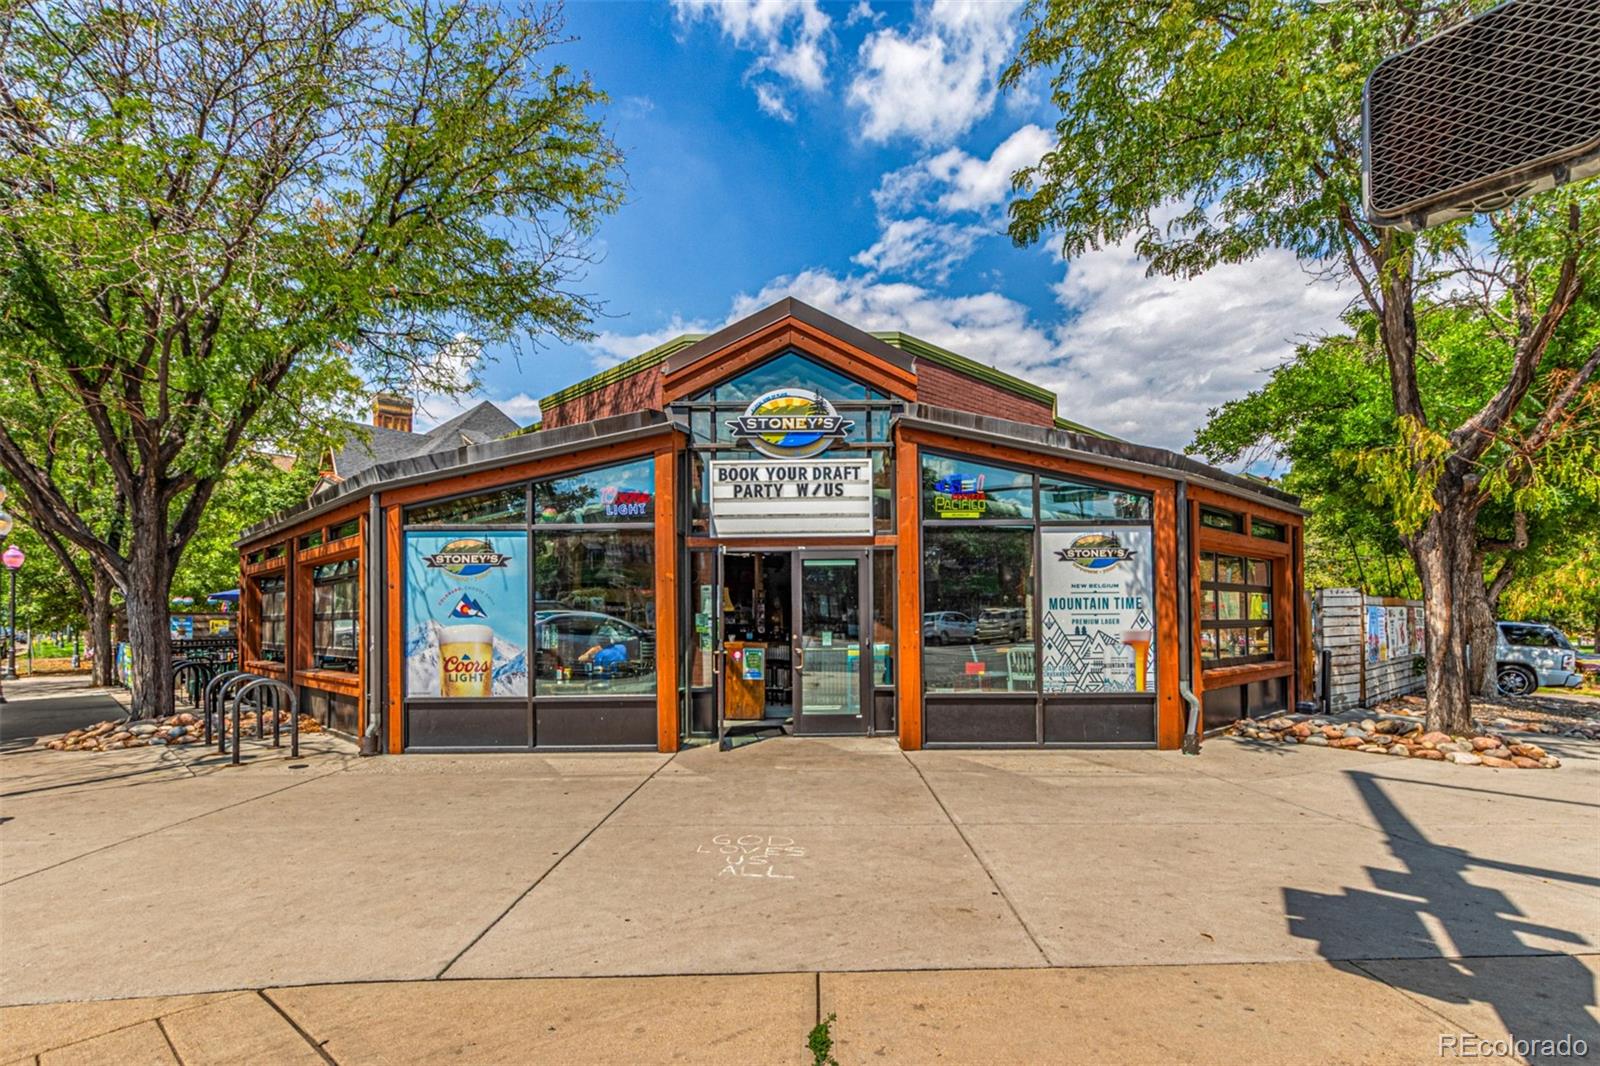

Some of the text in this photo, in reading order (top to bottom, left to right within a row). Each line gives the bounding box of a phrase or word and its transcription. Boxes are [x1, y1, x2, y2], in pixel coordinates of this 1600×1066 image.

[746, 418, 835, 430] STONEY'S
[718, 466, 861, 482] BOOK YOUR DRAFT
[733, 483, 784, 498] PARTY
[605, 503, 646, 516] LIGHT
[435, 554, 499, 563] STONEY'S
[1067, 549, 1125, 557] STONEY'S
[1048, 597, 1142, 610] MOUNTAIN TIME
[443, 655, 489, 673] Coors
[448, 673, 484, 683] LIGHT
[712, 834, 795, 846] GOD
[696, 845, 806, 857] LOVES
[726, 855, 769, 865] US
[718, 865, 795, 879] ALL
